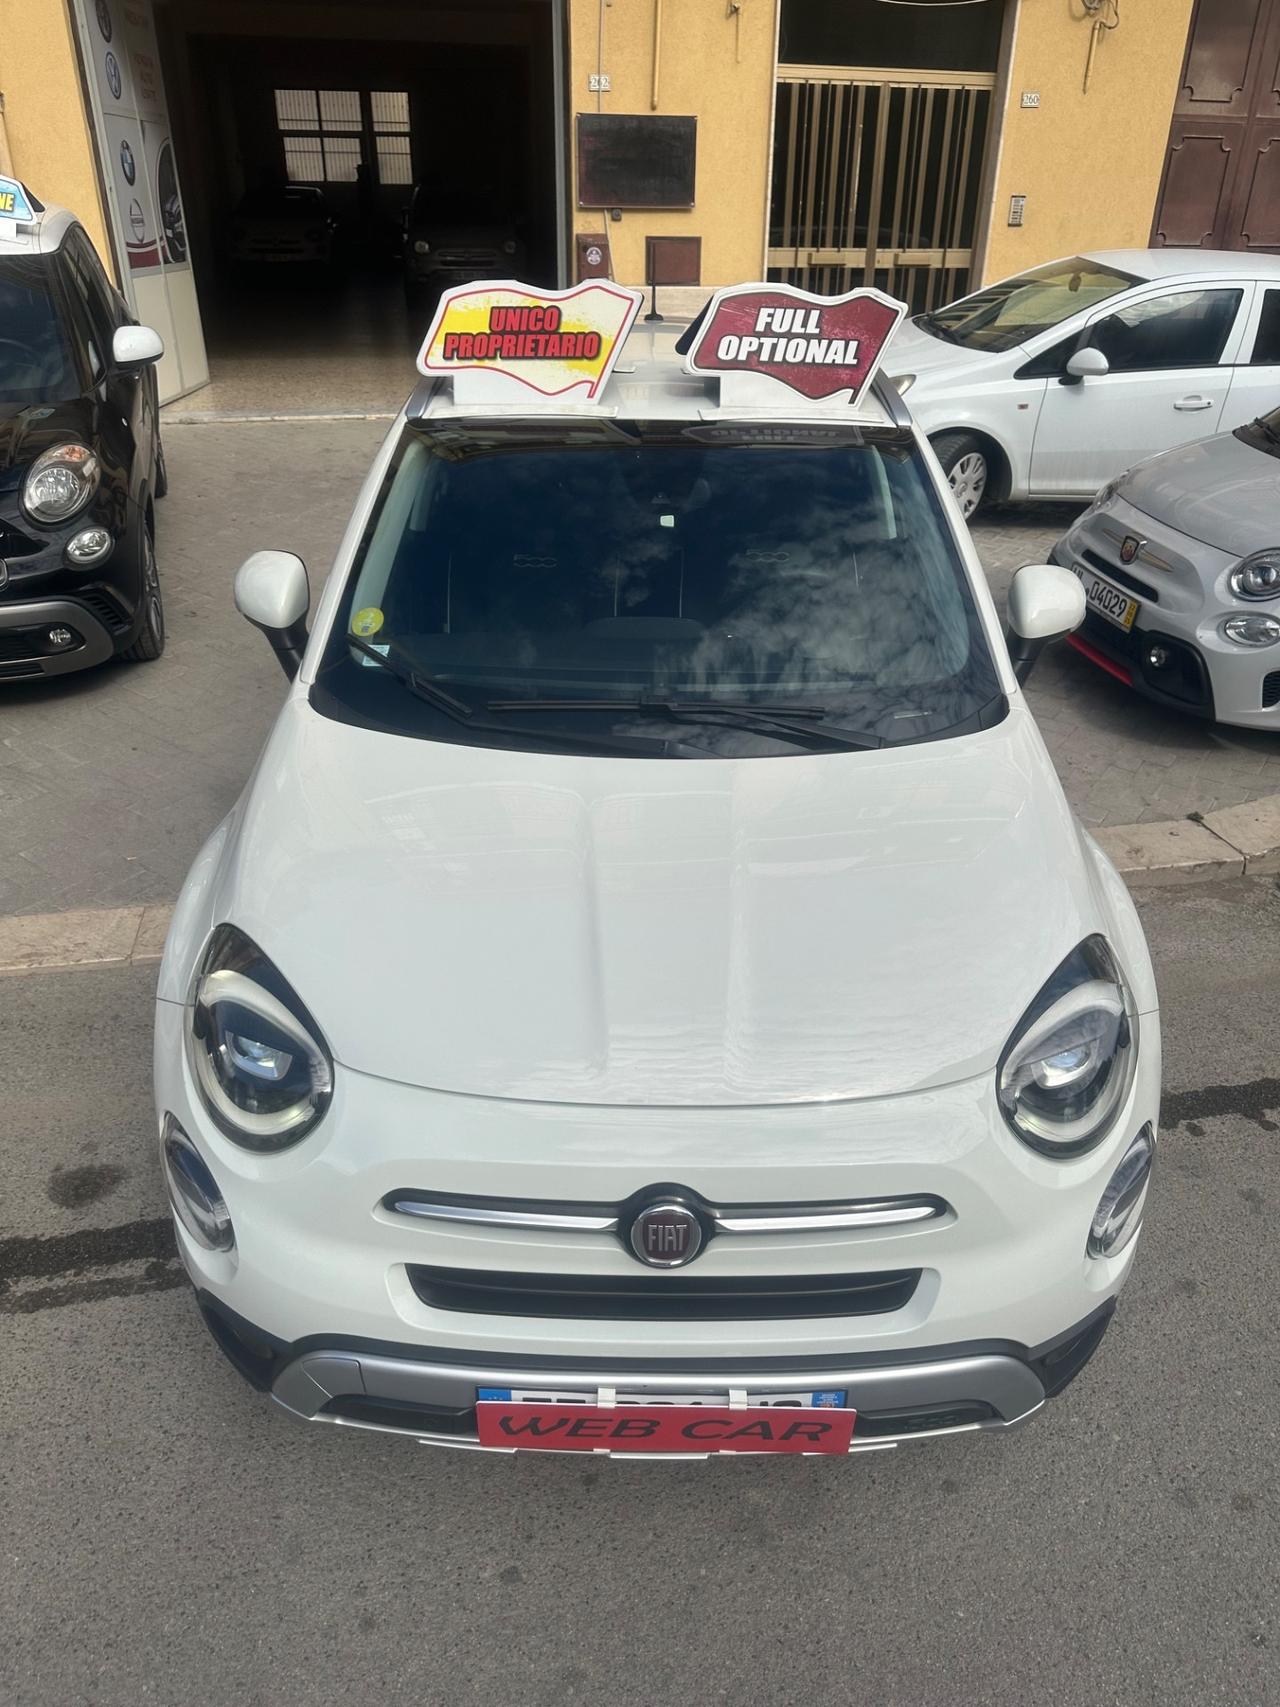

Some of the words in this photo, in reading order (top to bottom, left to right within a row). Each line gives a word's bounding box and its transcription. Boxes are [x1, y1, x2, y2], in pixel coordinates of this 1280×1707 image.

[489, 306, 562, 333] UNICO
[755, 307, 820, 334] FULL
[443, 332, 602, 360] PROPRIETARIO
[717, 334, 859, 365] OPTIONAL
[1089, 581, 1127, 618] 04029
[648, 1225, 687, 1252] FIAT
[499, 1416, 661, 1438] WEB
[681, 1420, 832, 1441] CAR
